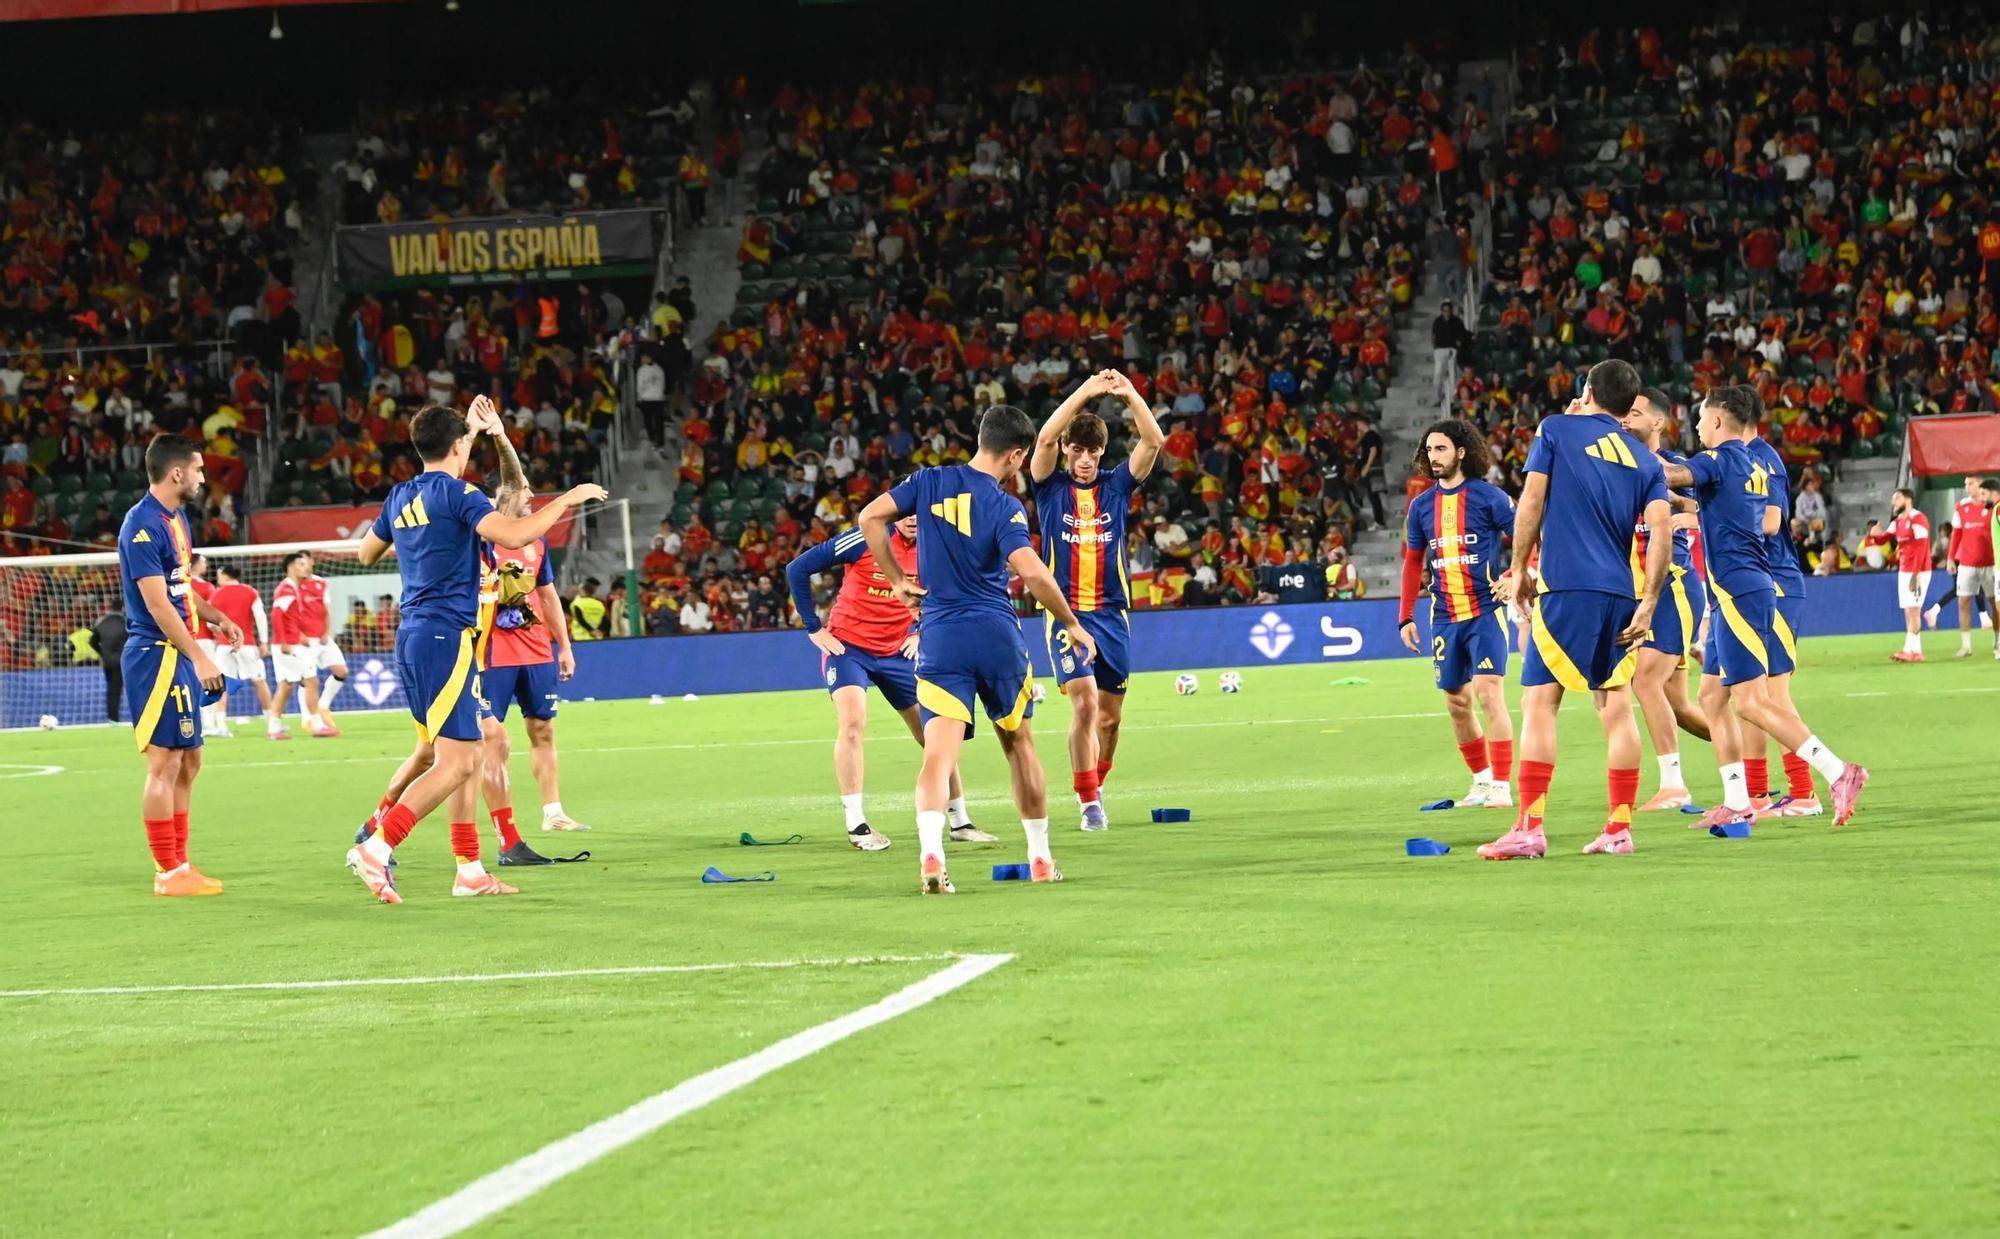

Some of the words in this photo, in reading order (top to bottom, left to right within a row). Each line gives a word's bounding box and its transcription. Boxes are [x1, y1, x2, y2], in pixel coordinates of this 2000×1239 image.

[495, 217, 601, 271] ESPAÑA
[1061, 531, 1113, 545] MAPFRE
[1279, 574, 1305, 588] rtve
[1056, 629, 1072, 653] 3
[1432, 635, 1446, 661] 2
[170, 684, 193, 713] 11
